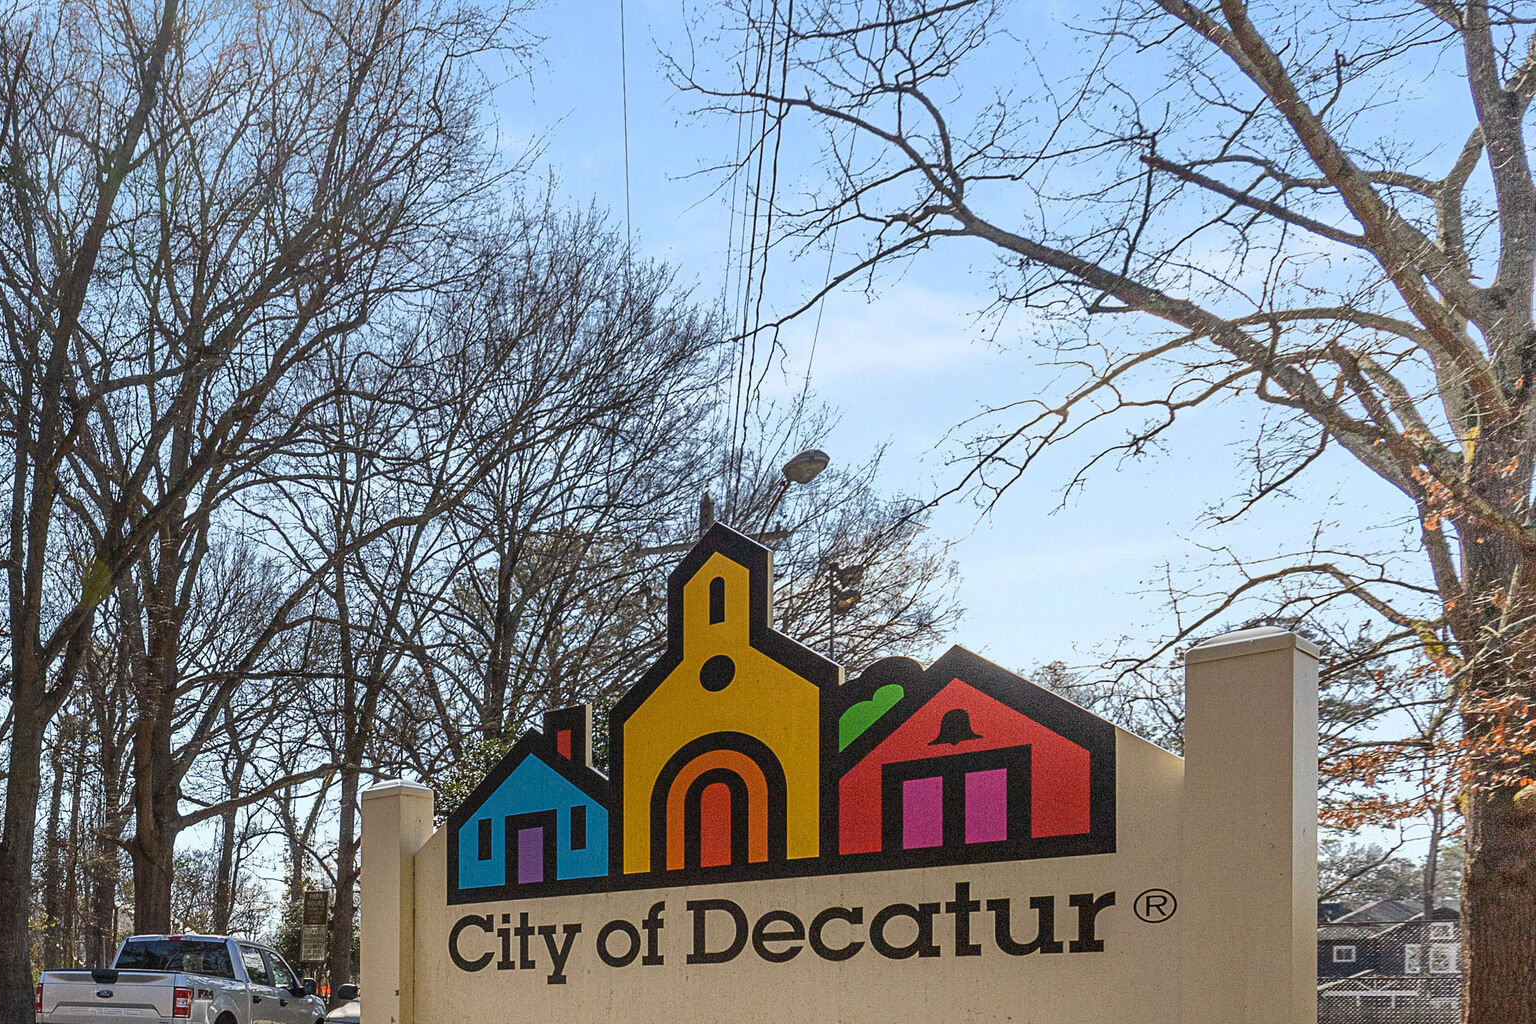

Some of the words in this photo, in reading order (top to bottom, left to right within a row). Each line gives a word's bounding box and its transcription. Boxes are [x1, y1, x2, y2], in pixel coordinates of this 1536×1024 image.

[448, 912, 582, 985] City
[596, 900, 666, 968] of
[686, 881, 1116, 965] Decatur
